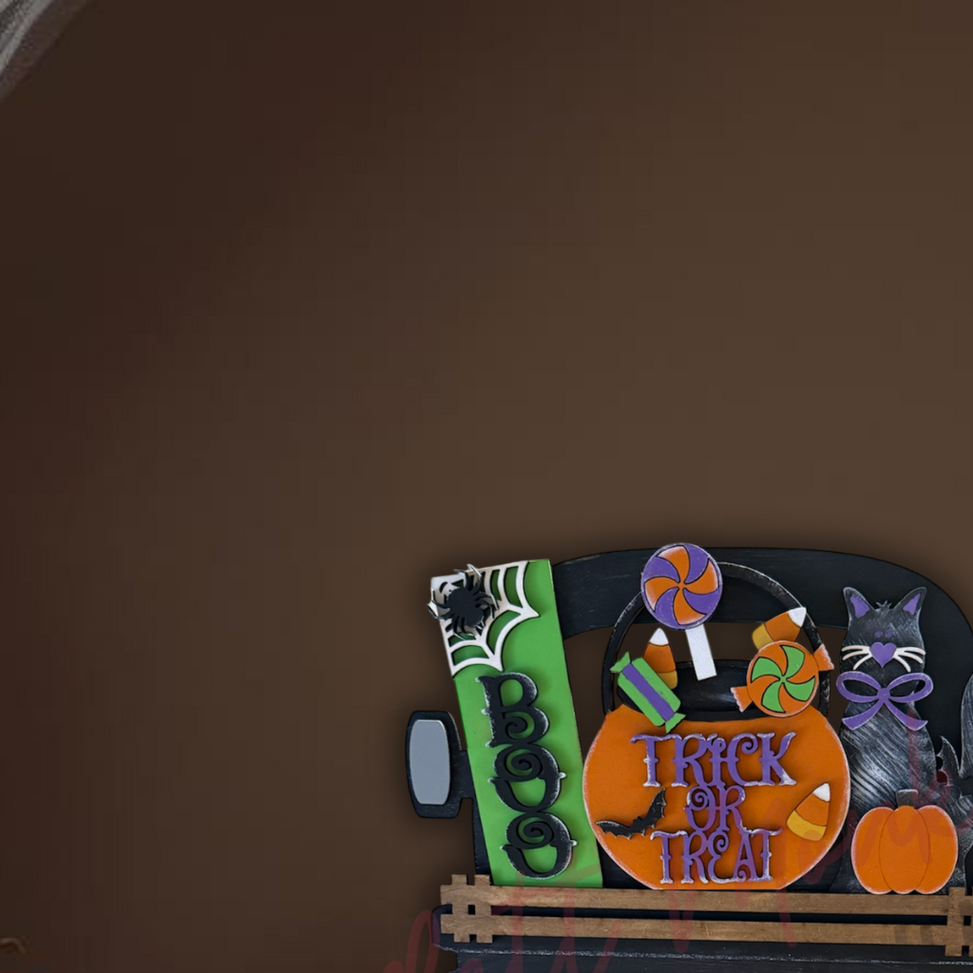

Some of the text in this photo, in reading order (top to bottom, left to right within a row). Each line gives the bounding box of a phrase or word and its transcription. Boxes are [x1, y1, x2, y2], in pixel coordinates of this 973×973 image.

[475, 672, 577, 880] BOO
[630, 731, 797, 788] TRICK
[685, 783, 747, 834] OR
[651, 828, 782, 885] TREAT
